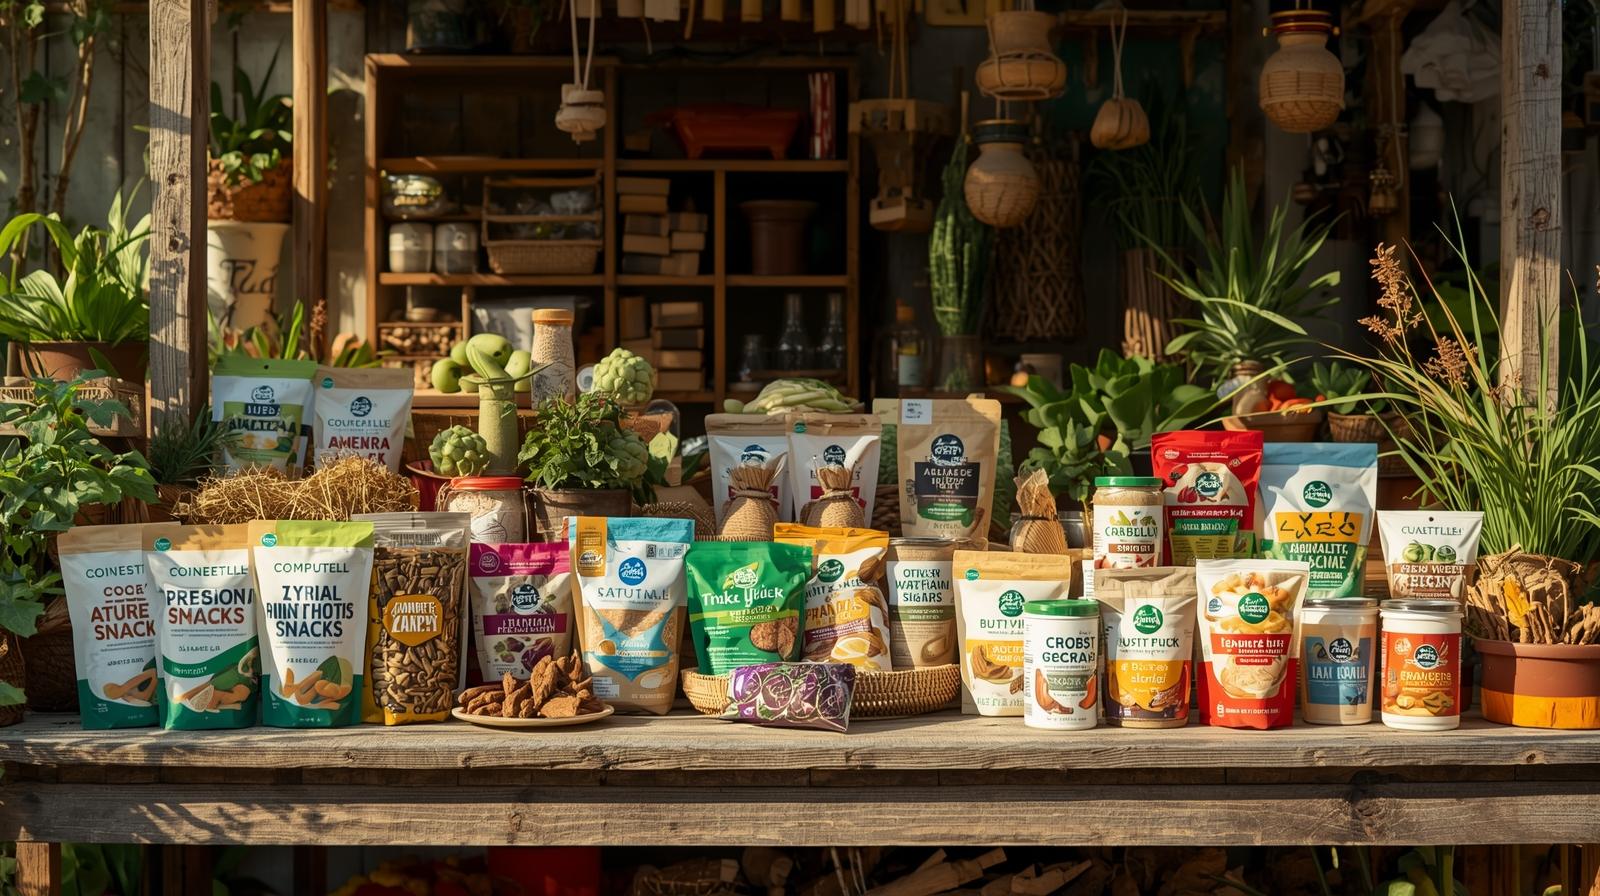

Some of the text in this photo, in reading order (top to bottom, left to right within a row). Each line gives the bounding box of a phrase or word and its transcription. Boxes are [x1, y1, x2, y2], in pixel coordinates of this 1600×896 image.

[274, 562, 349, 574] COMPUTELL
[91, 603, 150, 623] ATURE
[168, 607, 244, 625] SNACKS
[94, 620, 156, 641] SNACK
[276, 620, 343, 639] SNACKS
[1046, 636, 1095, 649] CROBST
